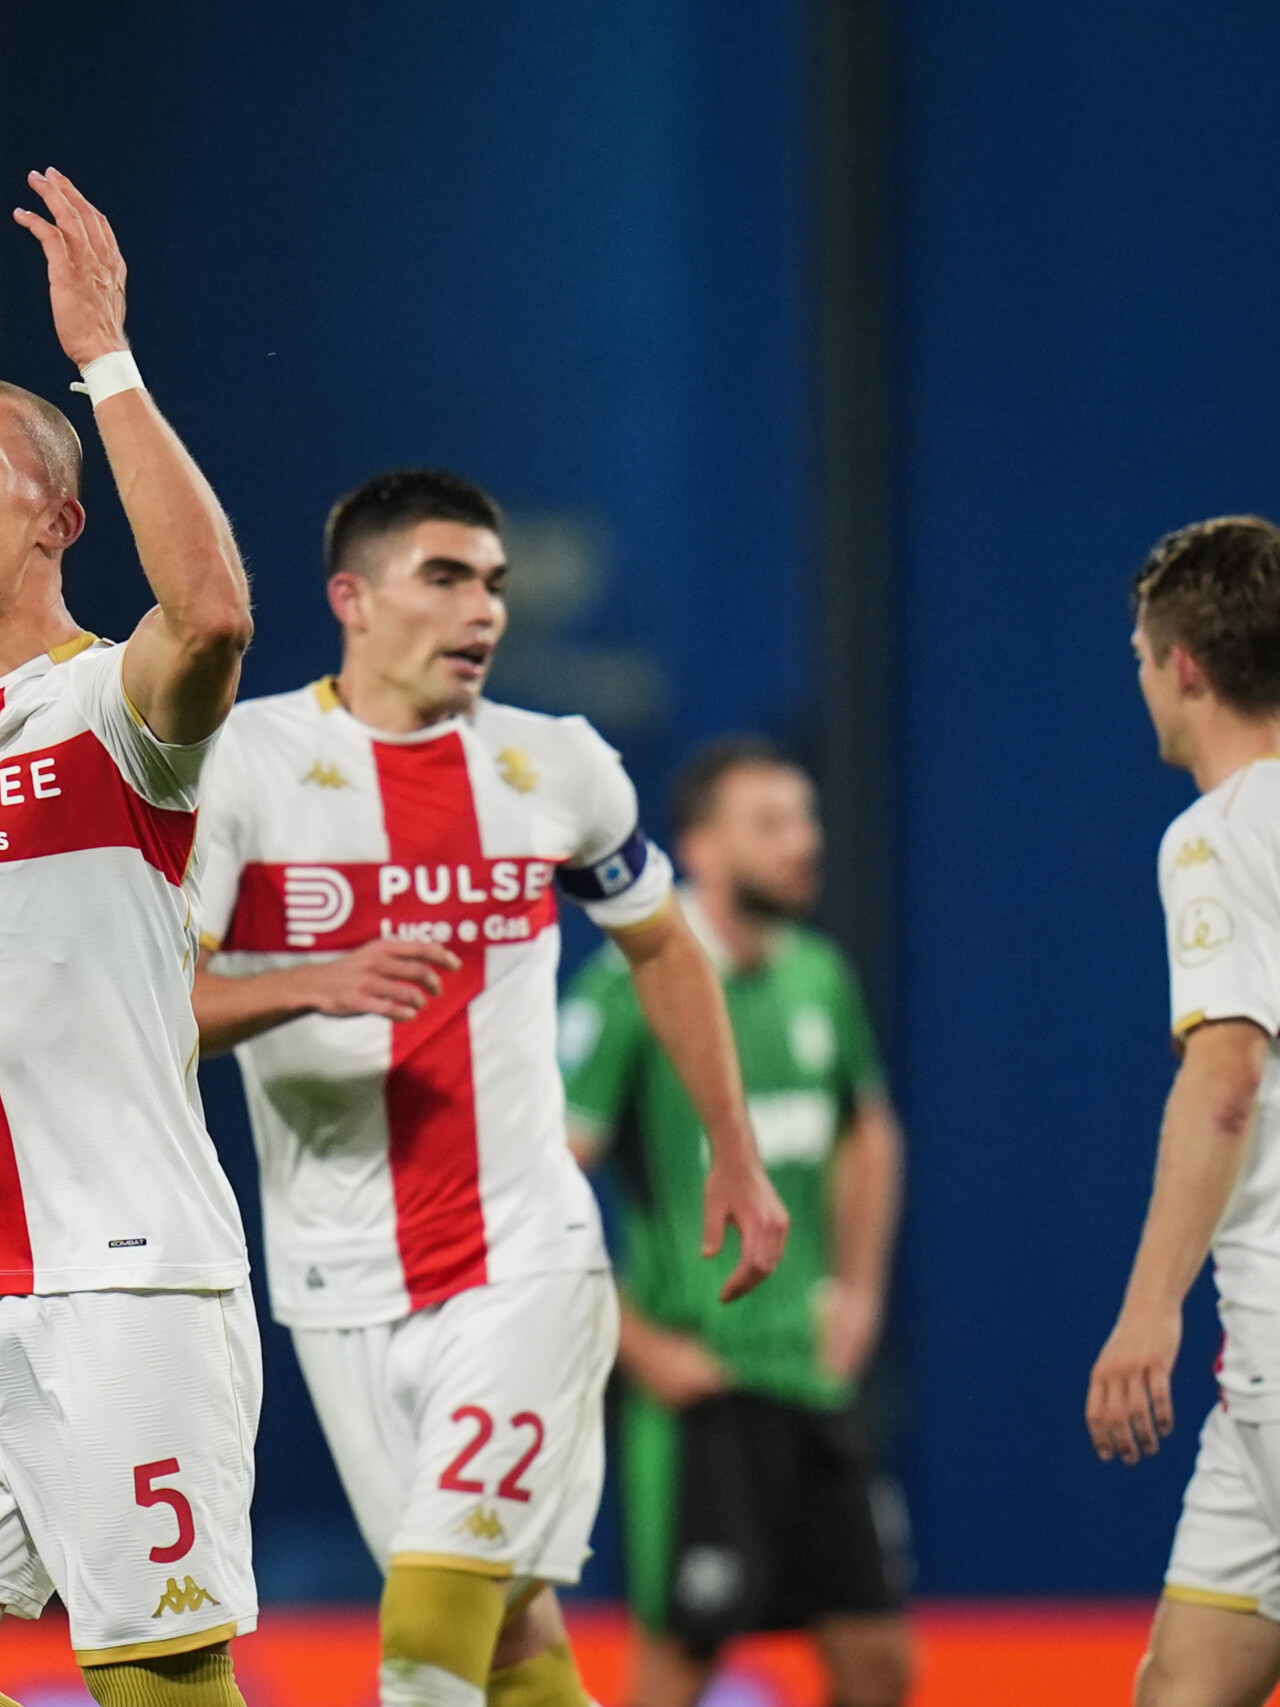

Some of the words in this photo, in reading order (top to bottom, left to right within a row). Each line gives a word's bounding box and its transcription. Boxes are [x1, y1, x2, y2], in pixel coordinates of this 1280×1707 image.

[378, 861, 555, 905] PULSE
[438, 1405, 546, 1503] 22
[133, 1457, 195, 1564] 5
